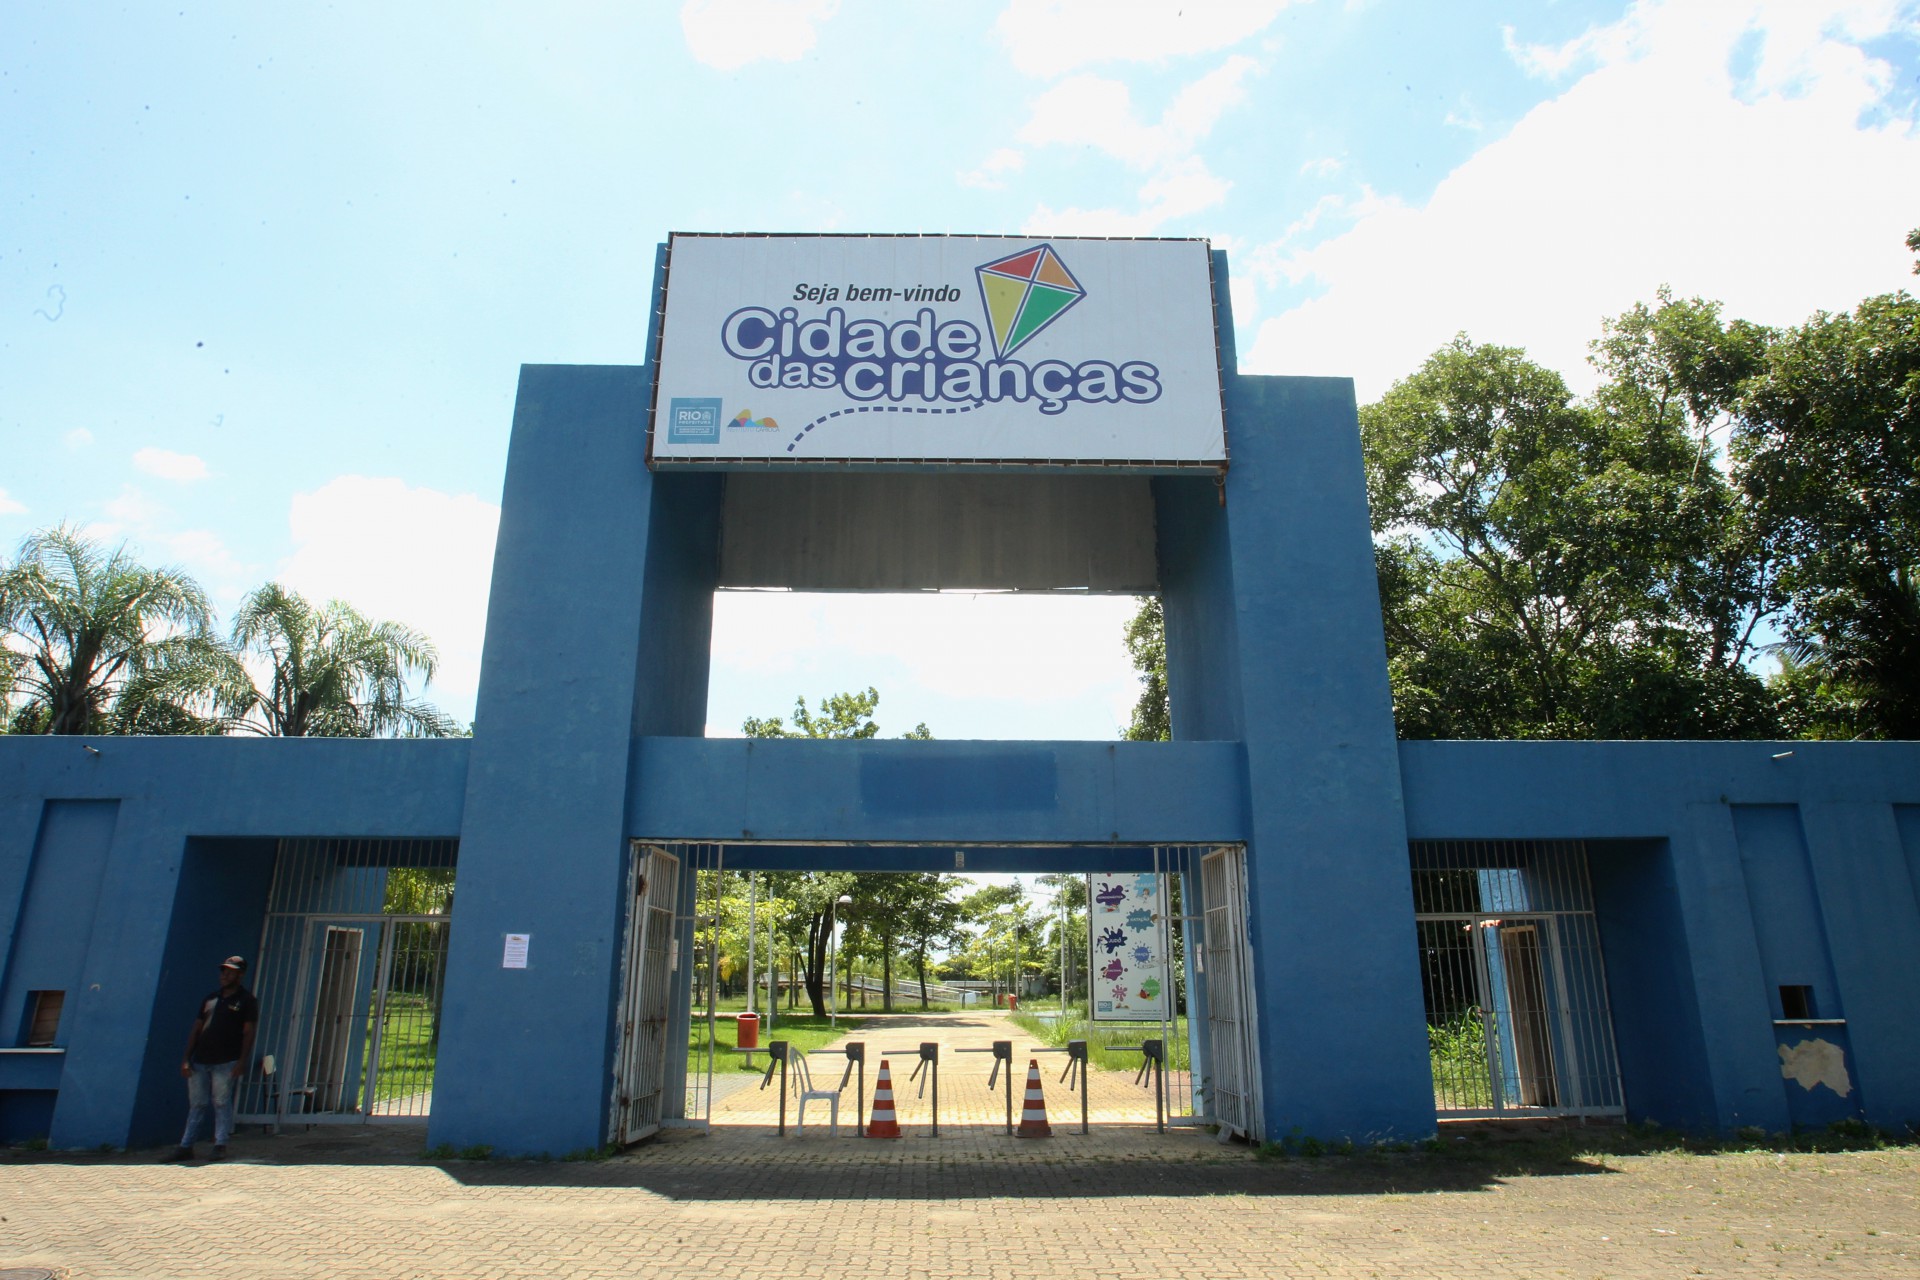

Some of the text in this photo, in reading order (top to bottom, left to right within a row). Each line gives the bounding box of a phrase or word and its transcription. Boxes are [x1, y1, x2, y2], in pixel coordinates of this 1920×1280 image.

[793, 283, 961, 304] Seja bem-vindo
[722, 307, 981, 360] Cidade
[749, 350, 1162, 414] das crianças
[679, 411, 701, 421] RIO
